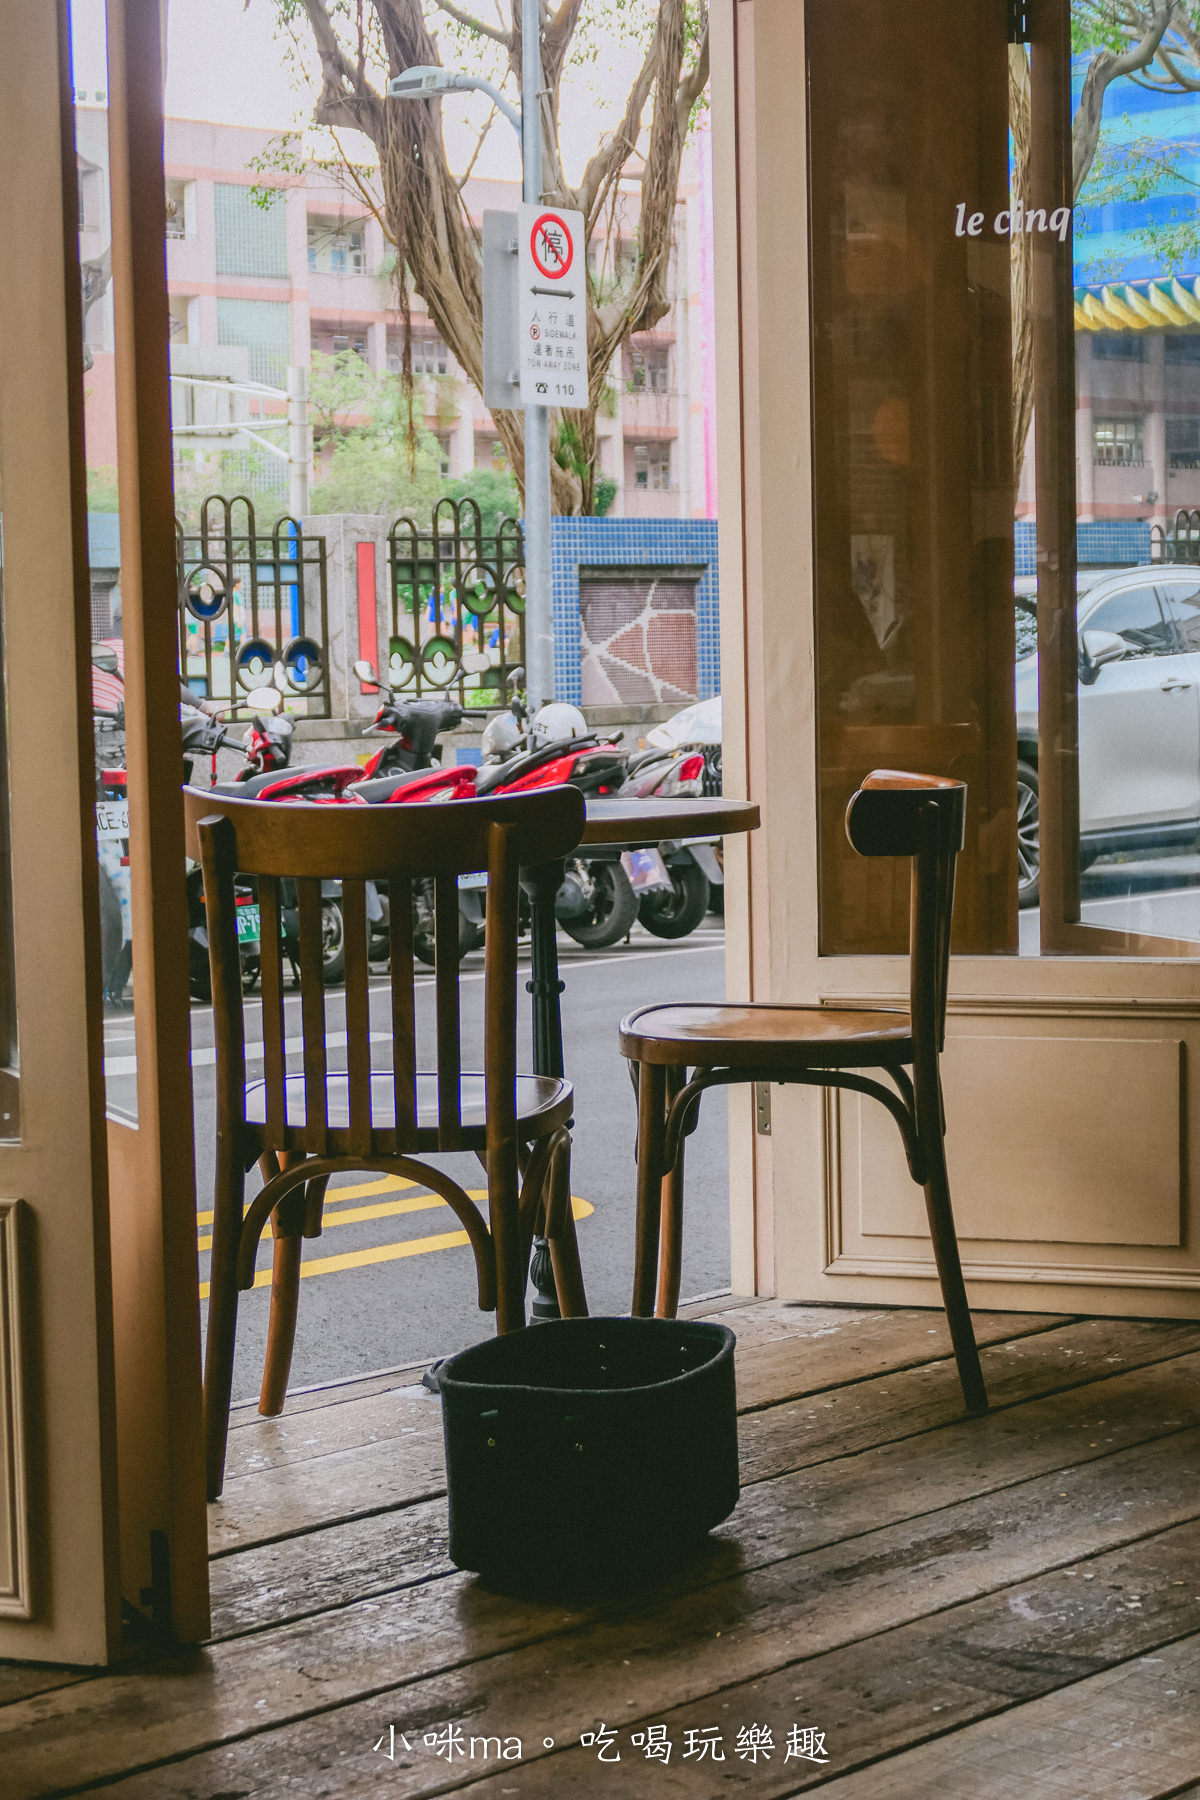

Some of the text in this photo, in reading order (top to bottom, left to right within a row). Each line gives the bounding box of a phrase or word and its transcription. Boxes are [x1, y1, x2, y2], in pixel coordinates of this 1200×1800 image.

[955, 199, 1071, 242] le cinq
[541, 228, 563, 264] 停
[531, 310, 575, 327] 人行道
[544, 328, 577, 340] SIDEWALK
[556, 383, 575, 396] 110
